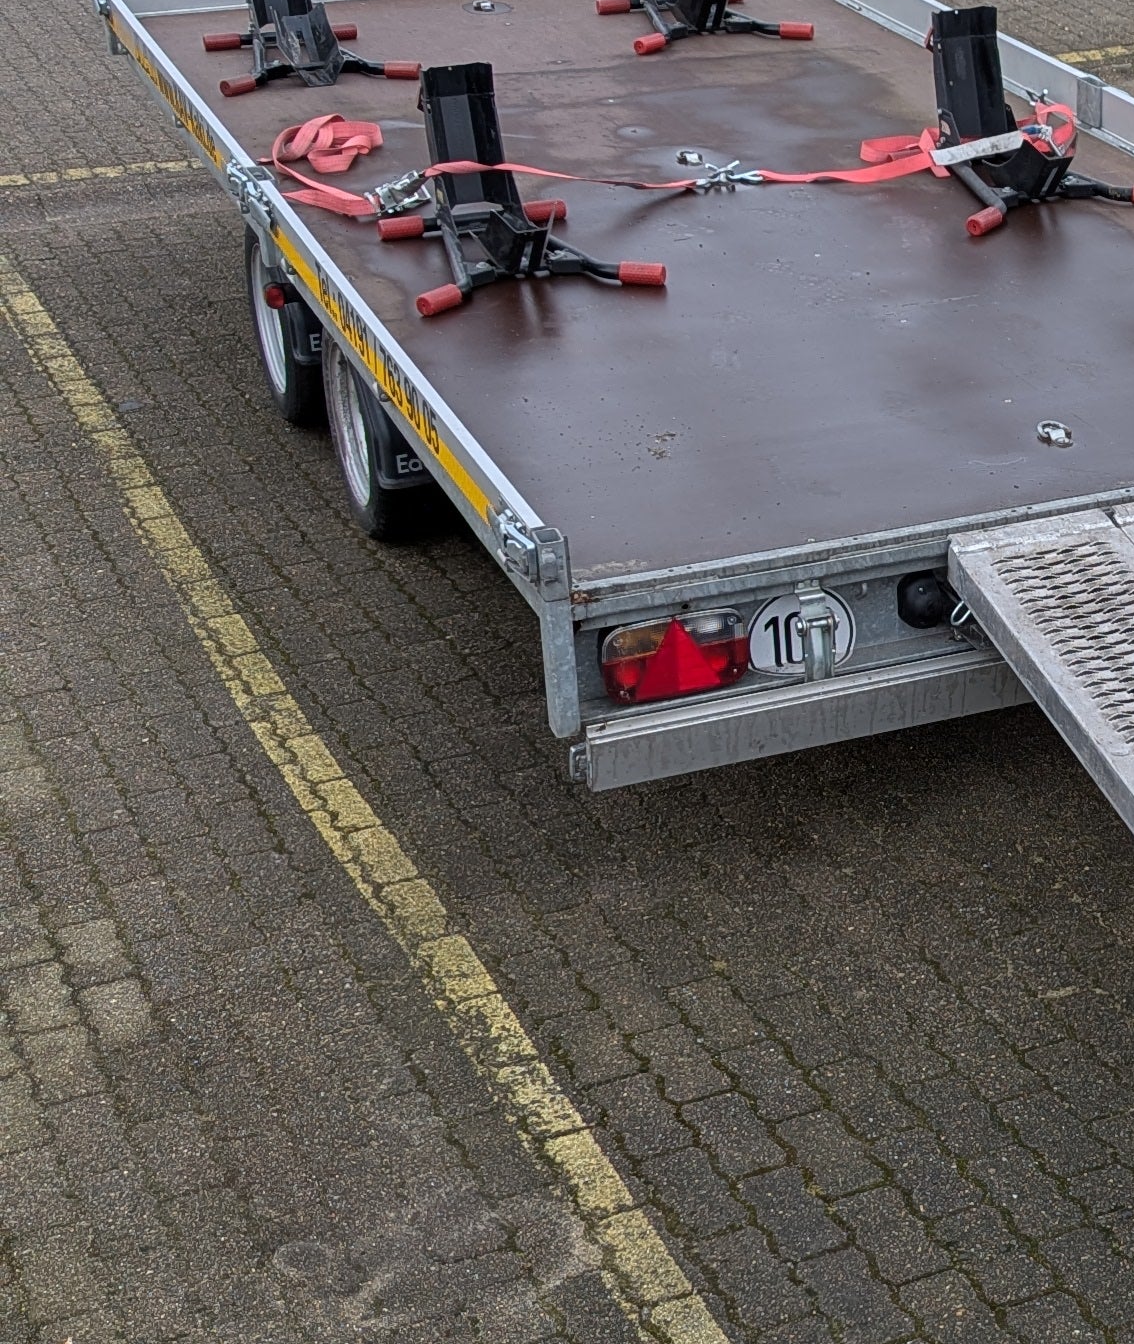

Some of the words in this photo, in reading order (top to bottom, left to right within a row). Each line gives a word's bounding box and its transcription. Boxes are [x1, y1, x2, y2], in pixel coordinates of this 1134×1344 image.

[338, 293, 370, 364] 04191
[380, 344, 403, 407] 763
[404, 377, 420, 431] 90
[423, 400, 440, 455] 05
[764, 611, 804, 668] 10
